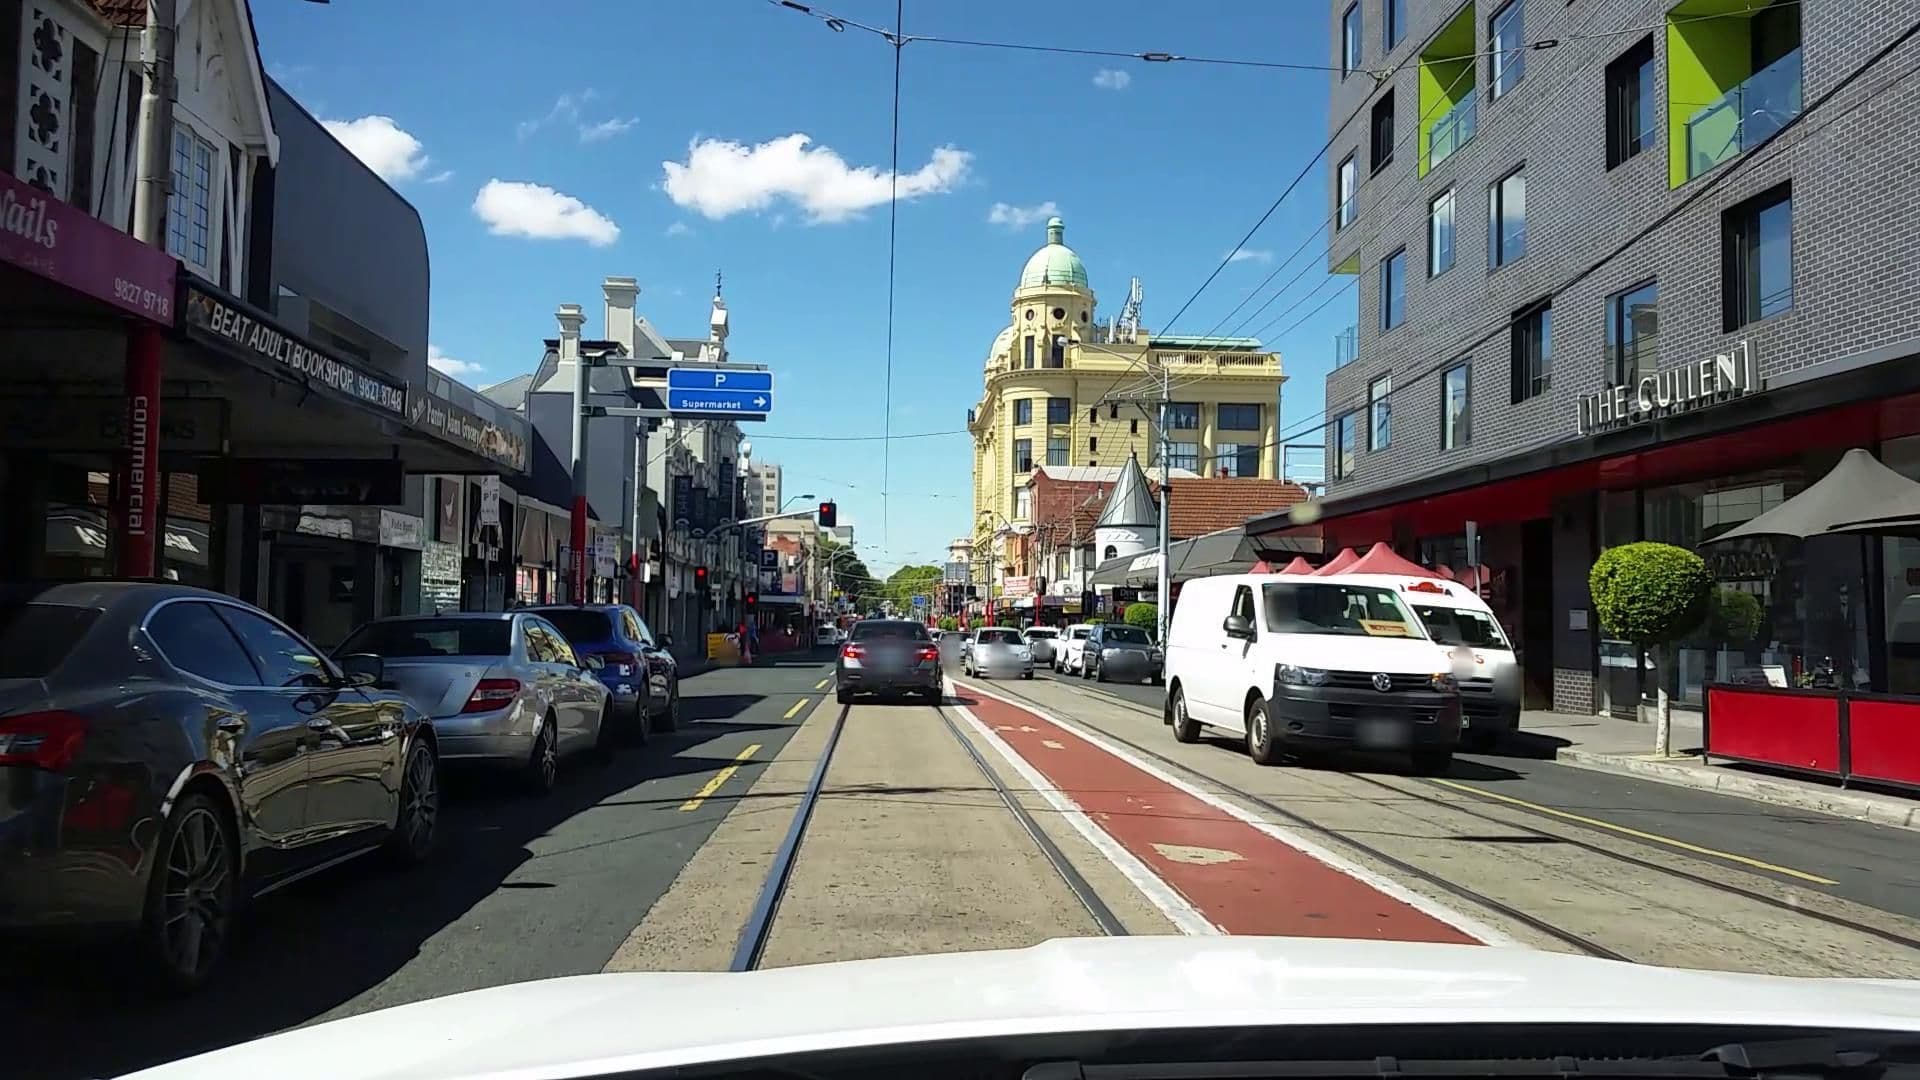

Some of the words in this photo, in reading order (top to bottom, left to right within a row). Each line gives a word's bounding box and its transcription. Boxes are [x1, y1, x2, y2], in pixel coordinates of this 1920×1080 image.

[114, 277, 140, 305] 9827
[143, 289, 169, 317] 9718
[211, 302, 251, 344] BEAT
[248, 324, 295, 364] ADULT
[292, 343, 354, 392] BOOKSHOP
[358, 375, 379, 402] 9827
[380, 385, 403, 411] 8748
[714, 373, 727, 388] P
[681, 399, 741, 410] Supermarket
[127, 396, 148, 535] commercial
[763, 551, 775, 566] P
